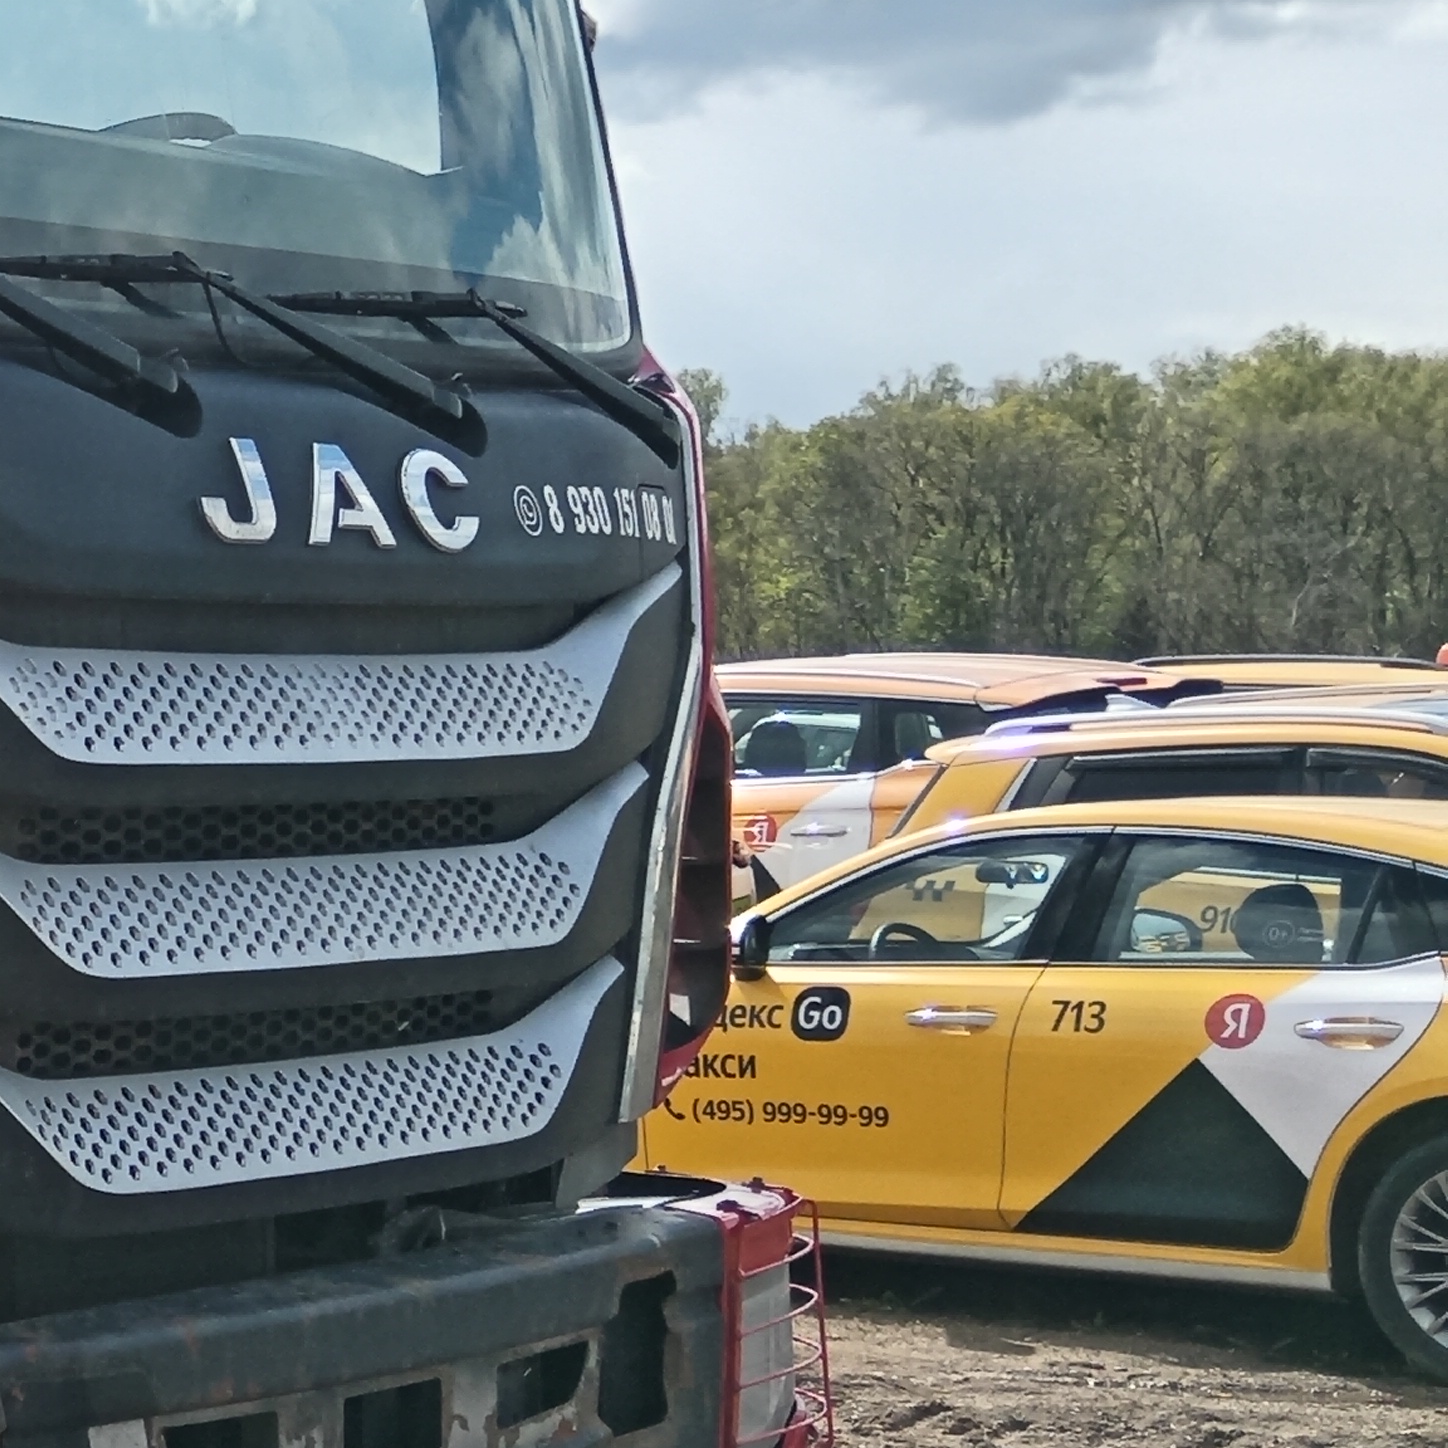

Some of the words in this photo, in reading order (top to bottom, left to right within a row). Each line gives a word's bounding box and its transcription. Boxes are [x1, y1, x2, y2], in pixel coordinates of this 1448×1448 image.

[199, 437, 481, 552] JAC
[543, 484, 565, 534] 8
[566, 485, 612, 536] 930
[613, 487, 641, 538] 151
[1200, 905, 1236, 934] 91
[797, 996, 843, 1030] Go
[1050, 1000, 1107, 1034] 713
[1218, 1002, 1251, 1038] Я
[685, 1053, 757, 1079] акси
[692, 1098, 754, 1125] (495)
[762, 1101, 890, 1128] 999-99-99
